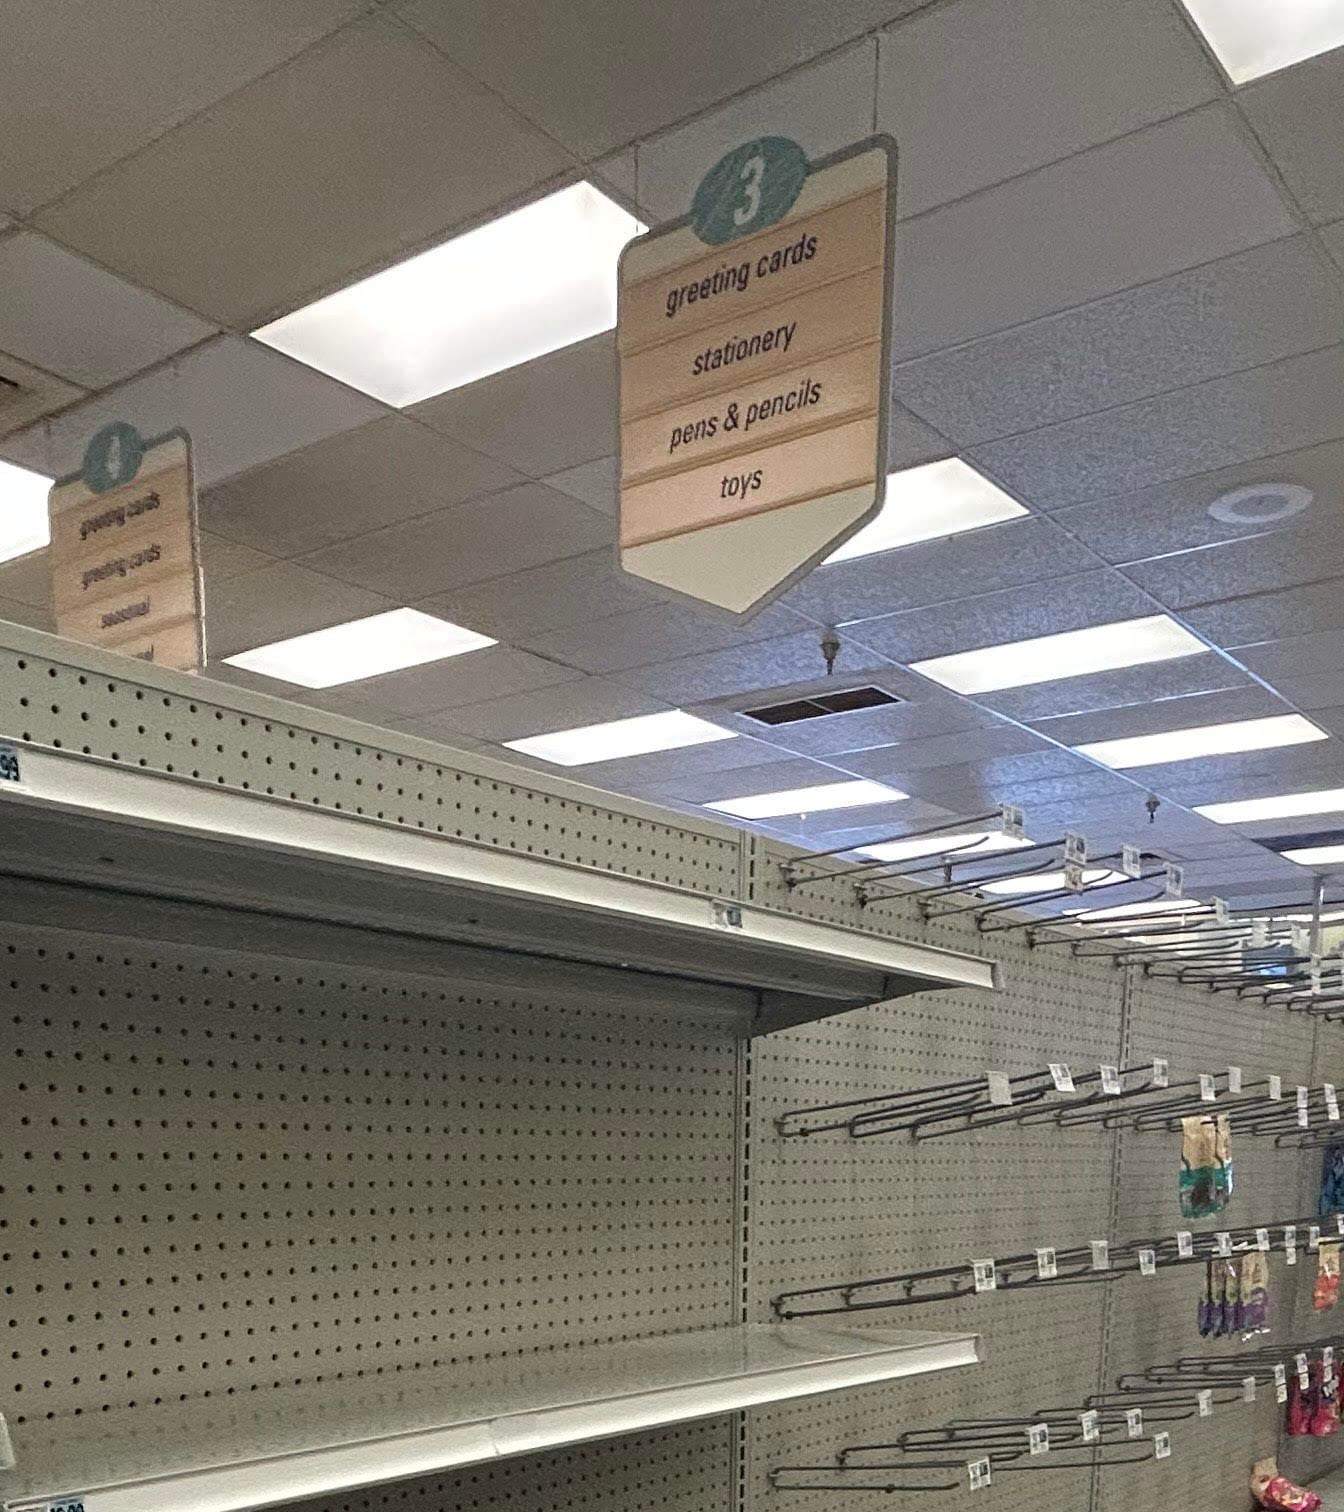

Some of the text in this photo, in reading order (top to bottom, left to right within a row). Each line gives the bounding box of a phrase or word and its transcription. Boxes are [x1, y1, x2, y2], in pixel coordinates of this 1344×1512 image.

[732, 154, 767, 227] 3
[665, 232, 818, 318] greeting cards
[691, 321, 797, 377] stationery
[669, 376, 823, 455] pens & pencils
[719, 468, 763, 500] toys
